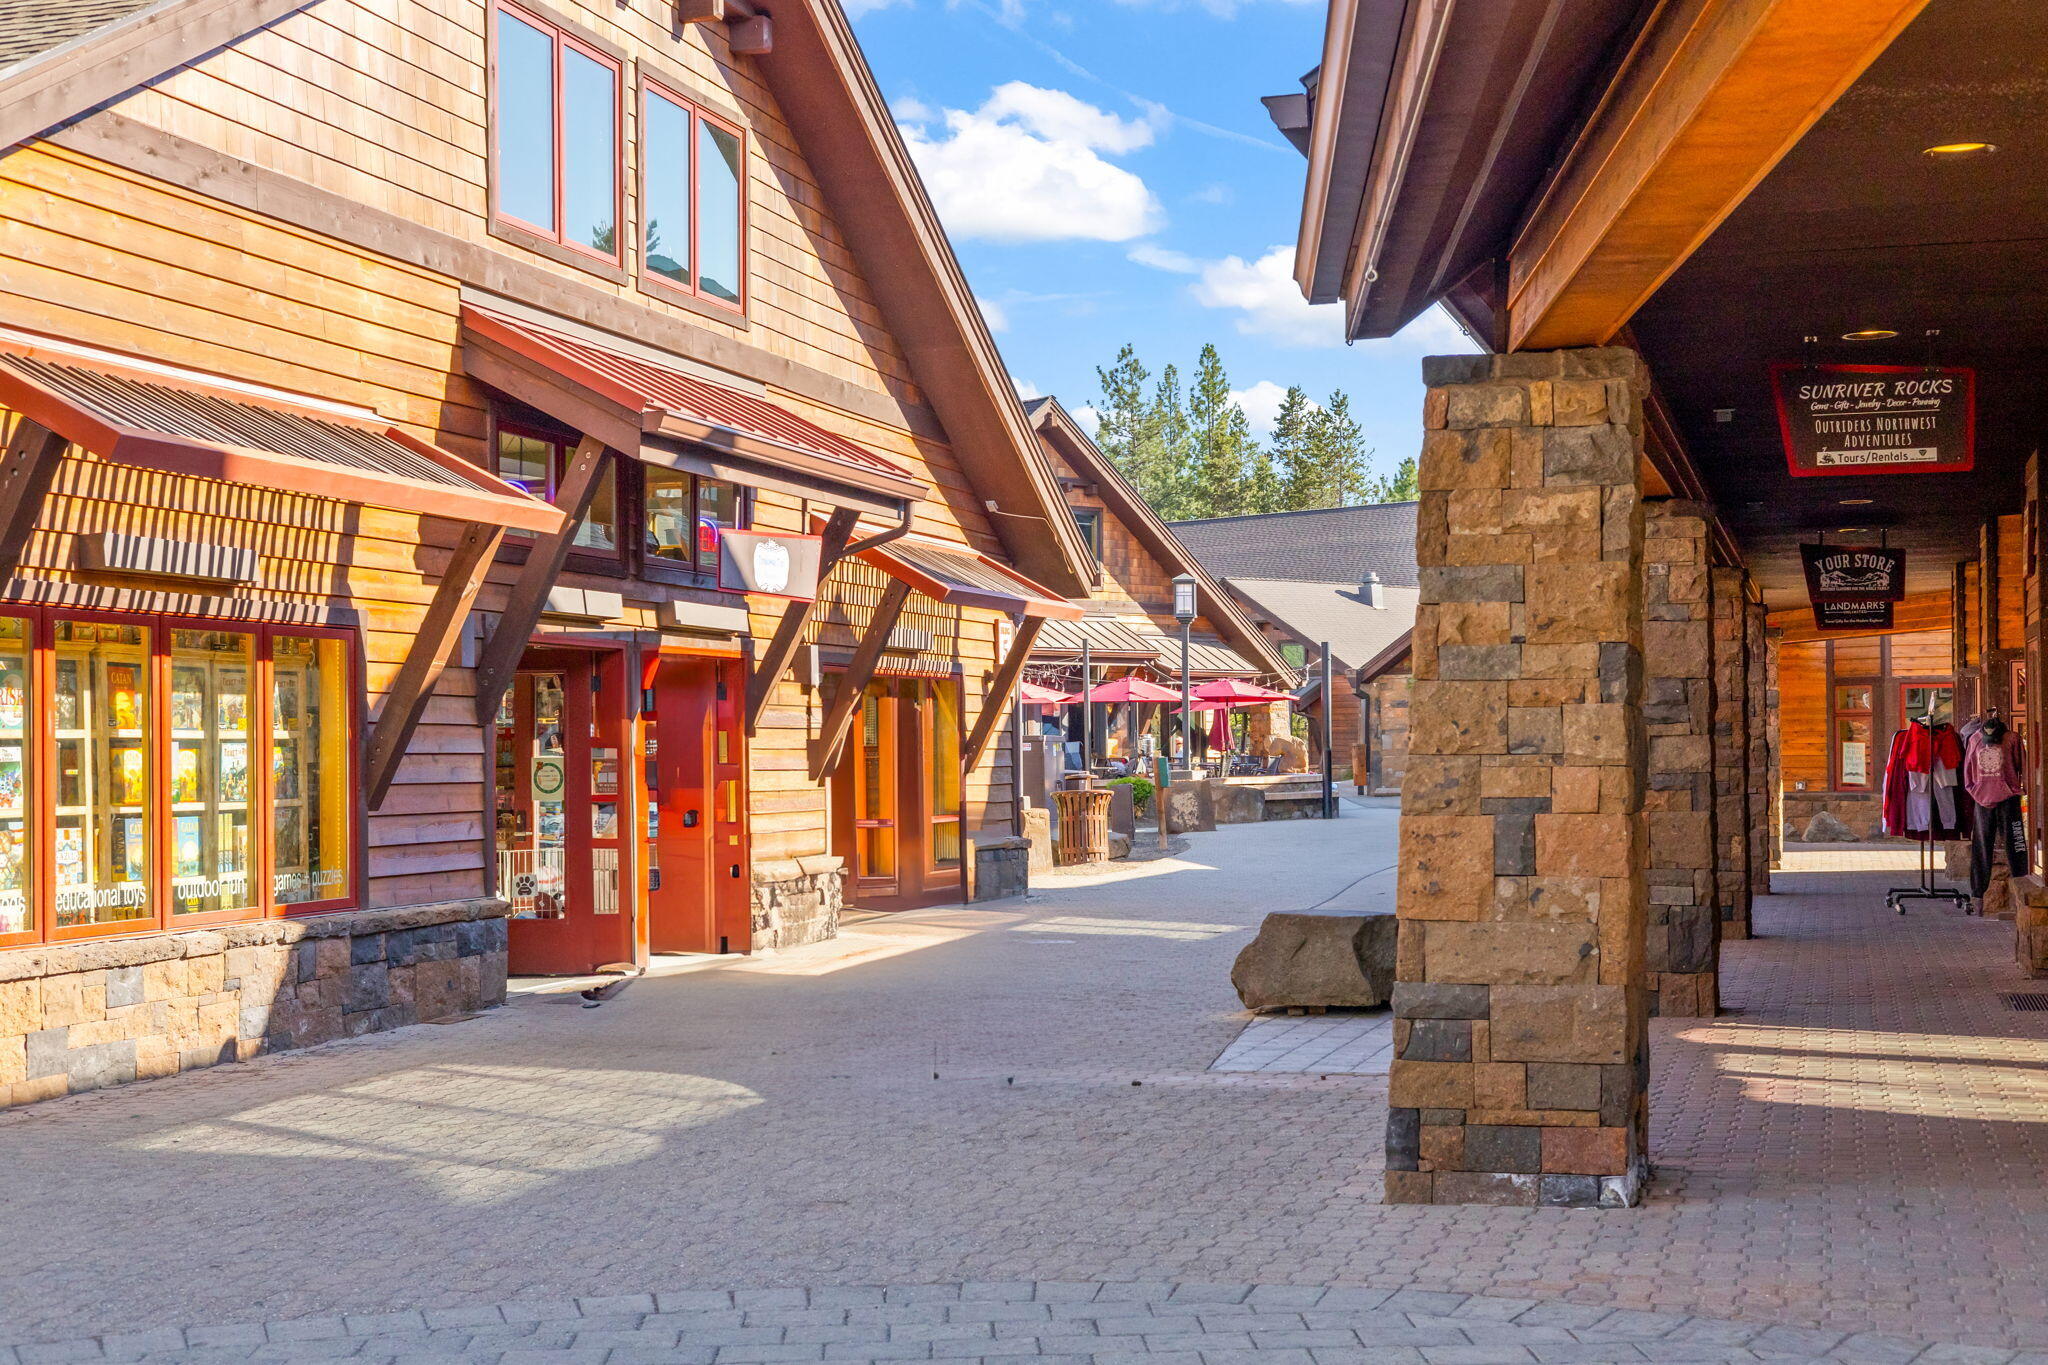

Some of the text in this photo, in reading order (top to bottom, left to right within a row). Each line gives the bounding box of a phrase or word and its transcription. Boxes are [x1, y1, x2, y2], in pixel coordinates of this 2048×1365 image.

[1799, 379, 1953, 400] SUNRIVER ROCKS
[1876, 416, 1937, 431] NORTHWEST
[1844, 432, 1912, 448] ADVENTURES
[1837, 451, 1909, 464] Tours/Rentals
[1814, 553, 1896, 574] YOUR STORE
[1824, 601, 1885, 611] LANDMARKS
[111, 671, 132, 685] CATAN
[178, 878, 223, 900] outdoor
[273, 872, 302, 897] games
[312, 866, 343, 892] puzzles
[55, 883, 121, 912] educaional
[122, 884, 147, 910] toys
